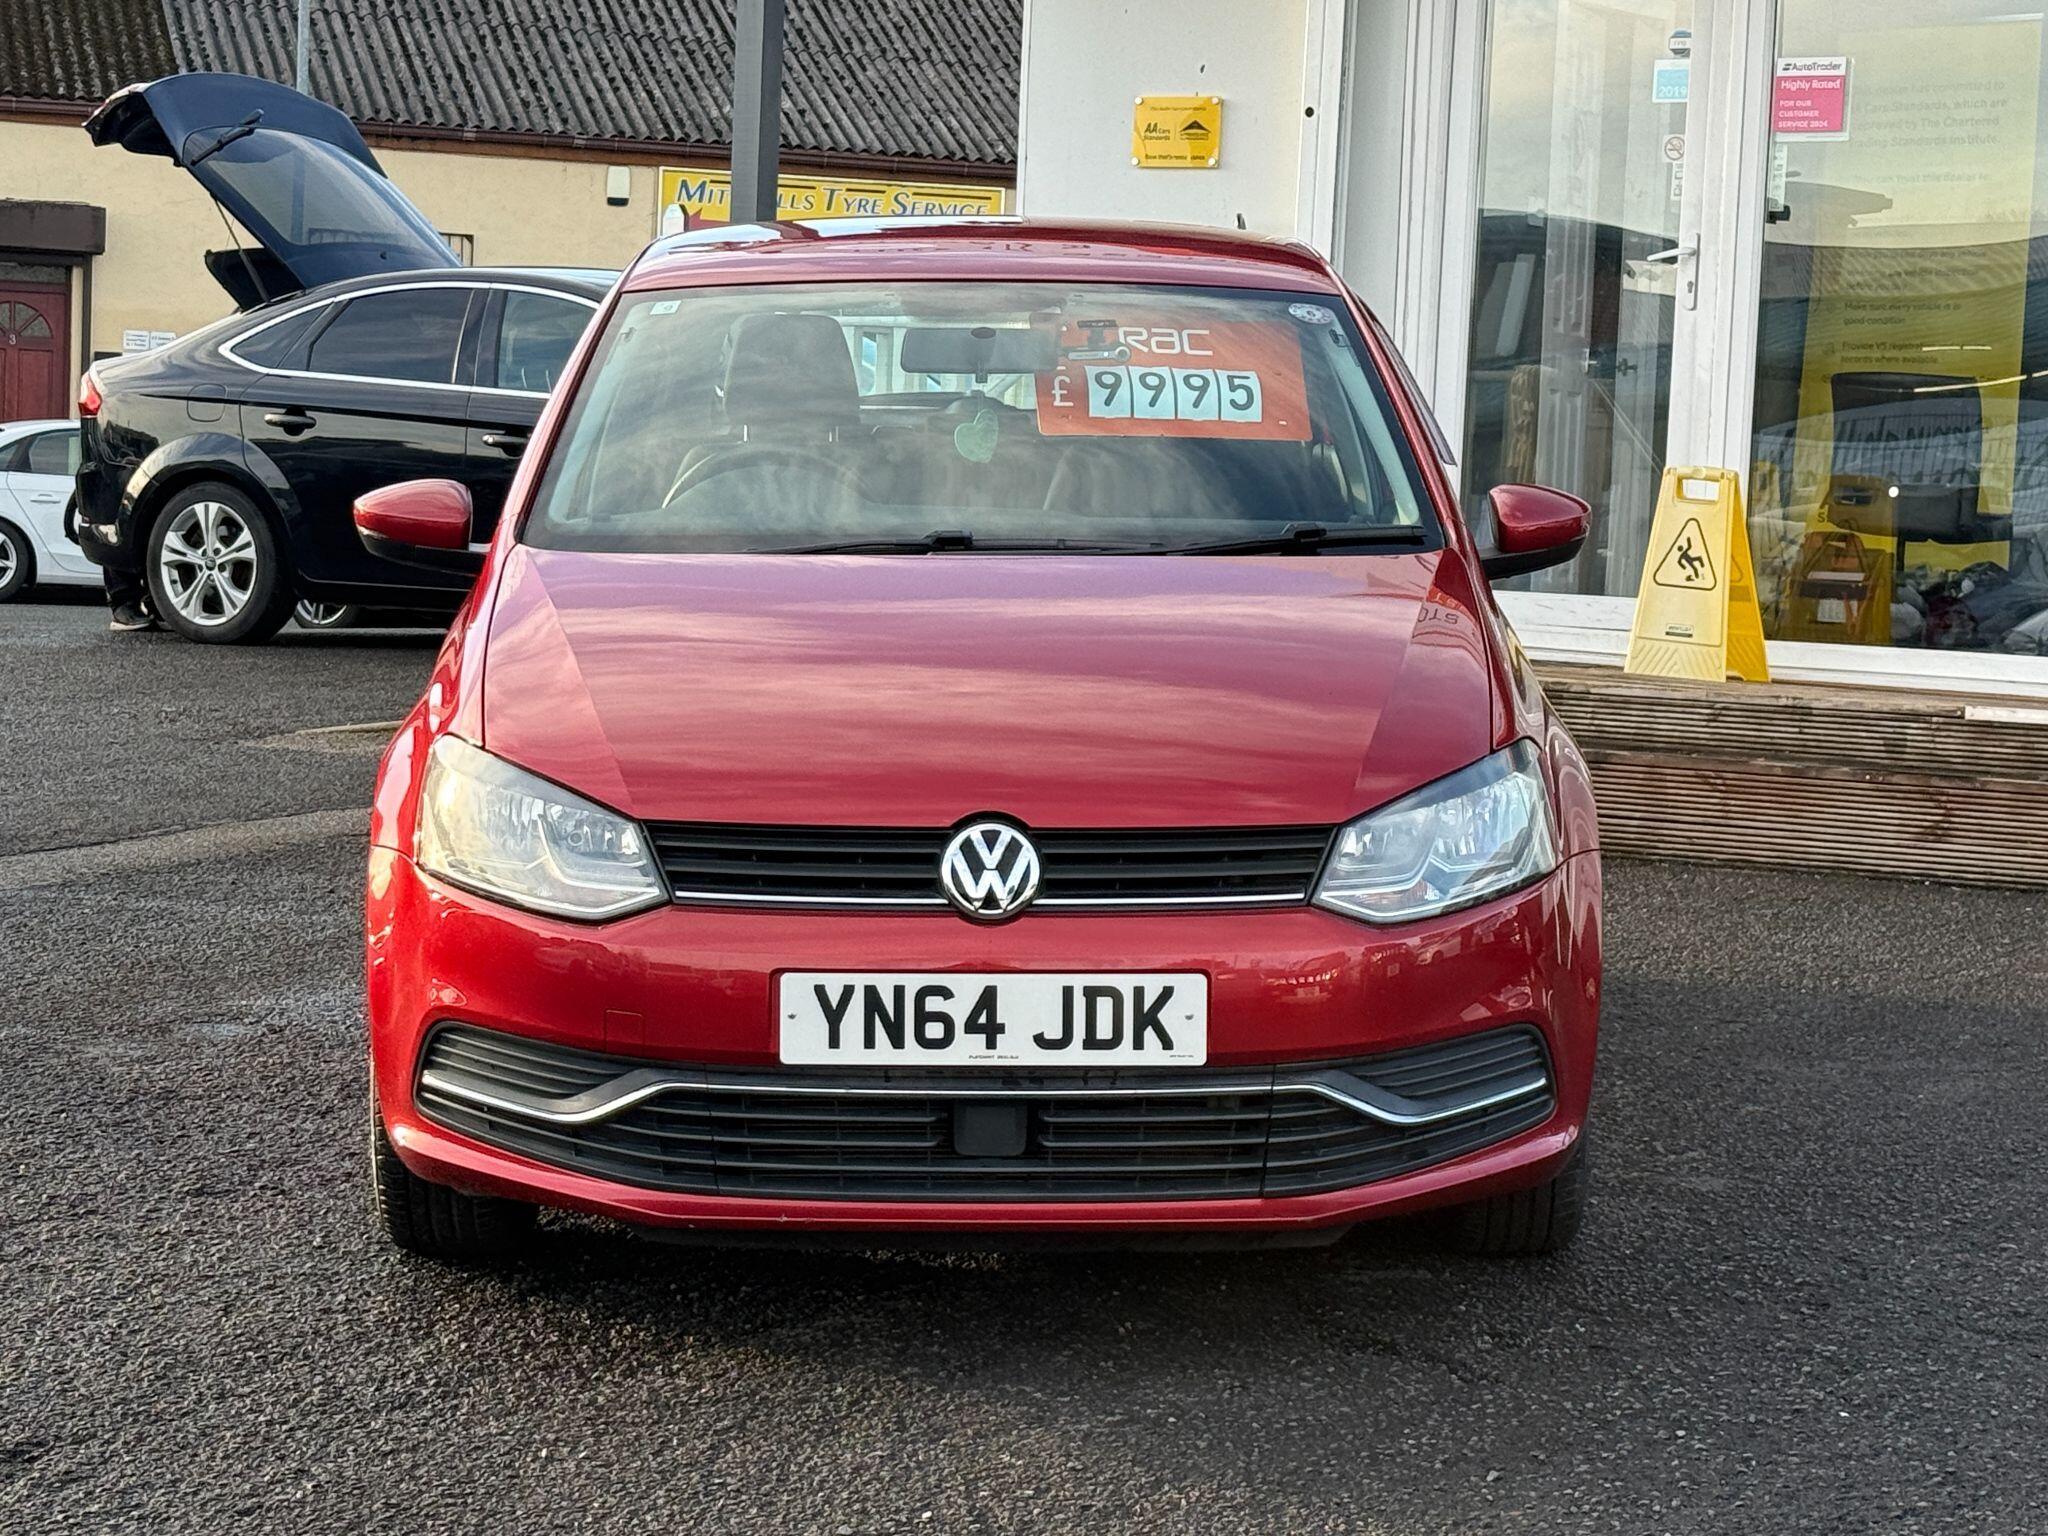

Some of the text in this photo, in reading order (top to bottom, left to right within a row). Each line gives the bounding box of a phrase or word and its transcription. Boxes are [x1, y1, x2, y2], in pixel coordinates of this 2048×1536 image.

[1791, 62, 1843, 72] AutoTrader
[1781, 79, 1841, 91] Highly Rated
[677, 179, 988, 216] MITLLS TYRE SERVICE
[9, 334, 17, 345] 3
[813, 984, 1175, 1051] YN64 JDK
